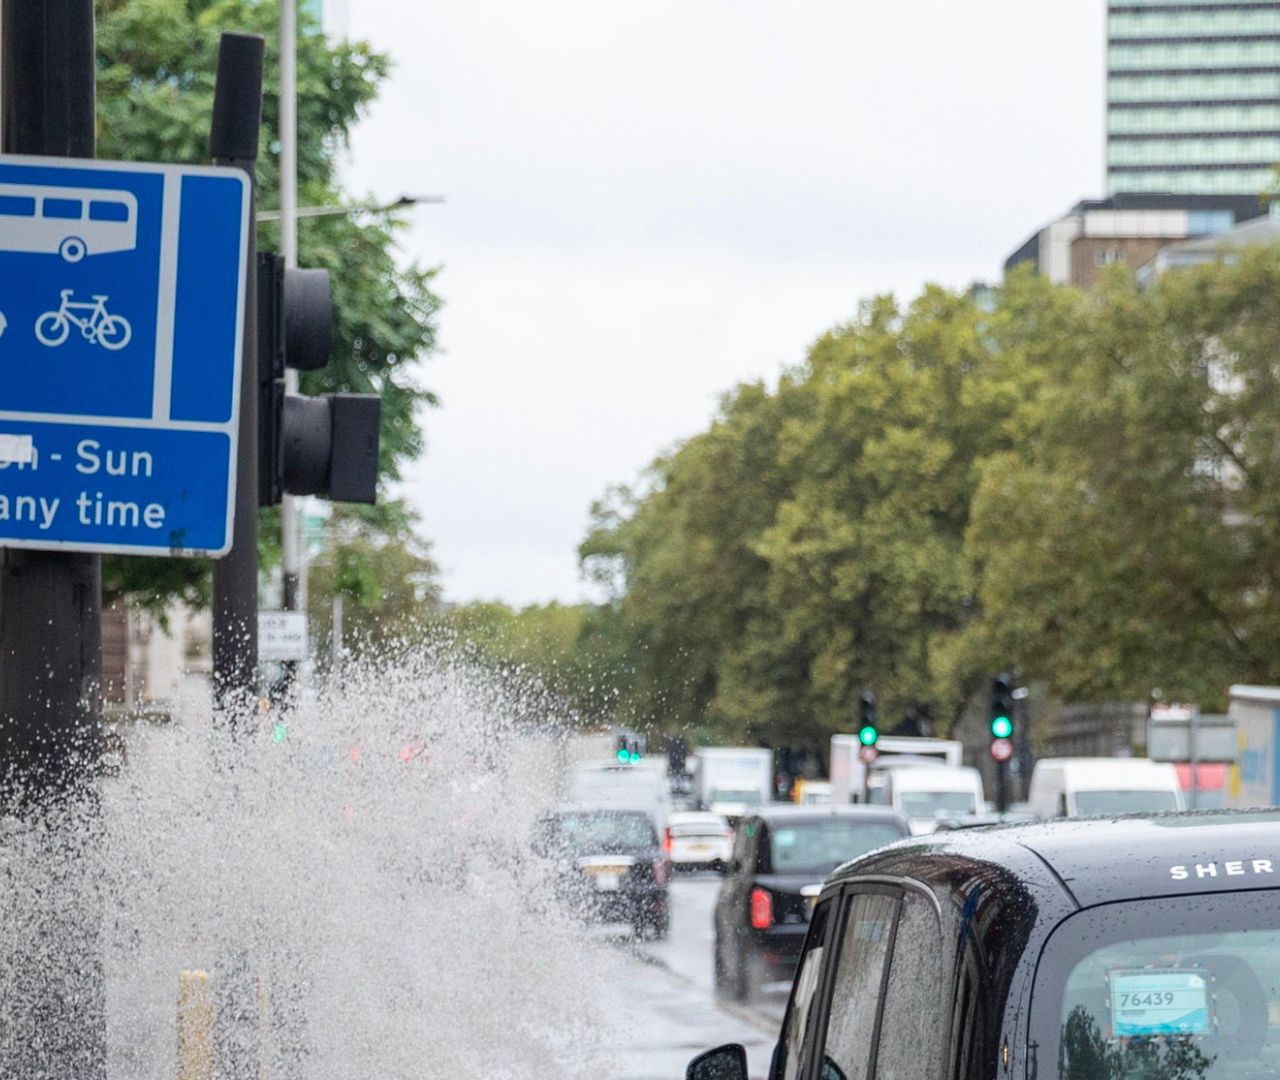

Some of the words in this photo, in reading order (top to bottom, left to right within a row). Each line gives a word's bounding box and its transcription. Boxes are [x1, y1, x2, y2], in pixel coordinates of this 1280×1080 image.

[75, 439, 154, 477] Sun
[76, 491, 165, 529] time
[1121, 991, 1175, 1007] 76439
